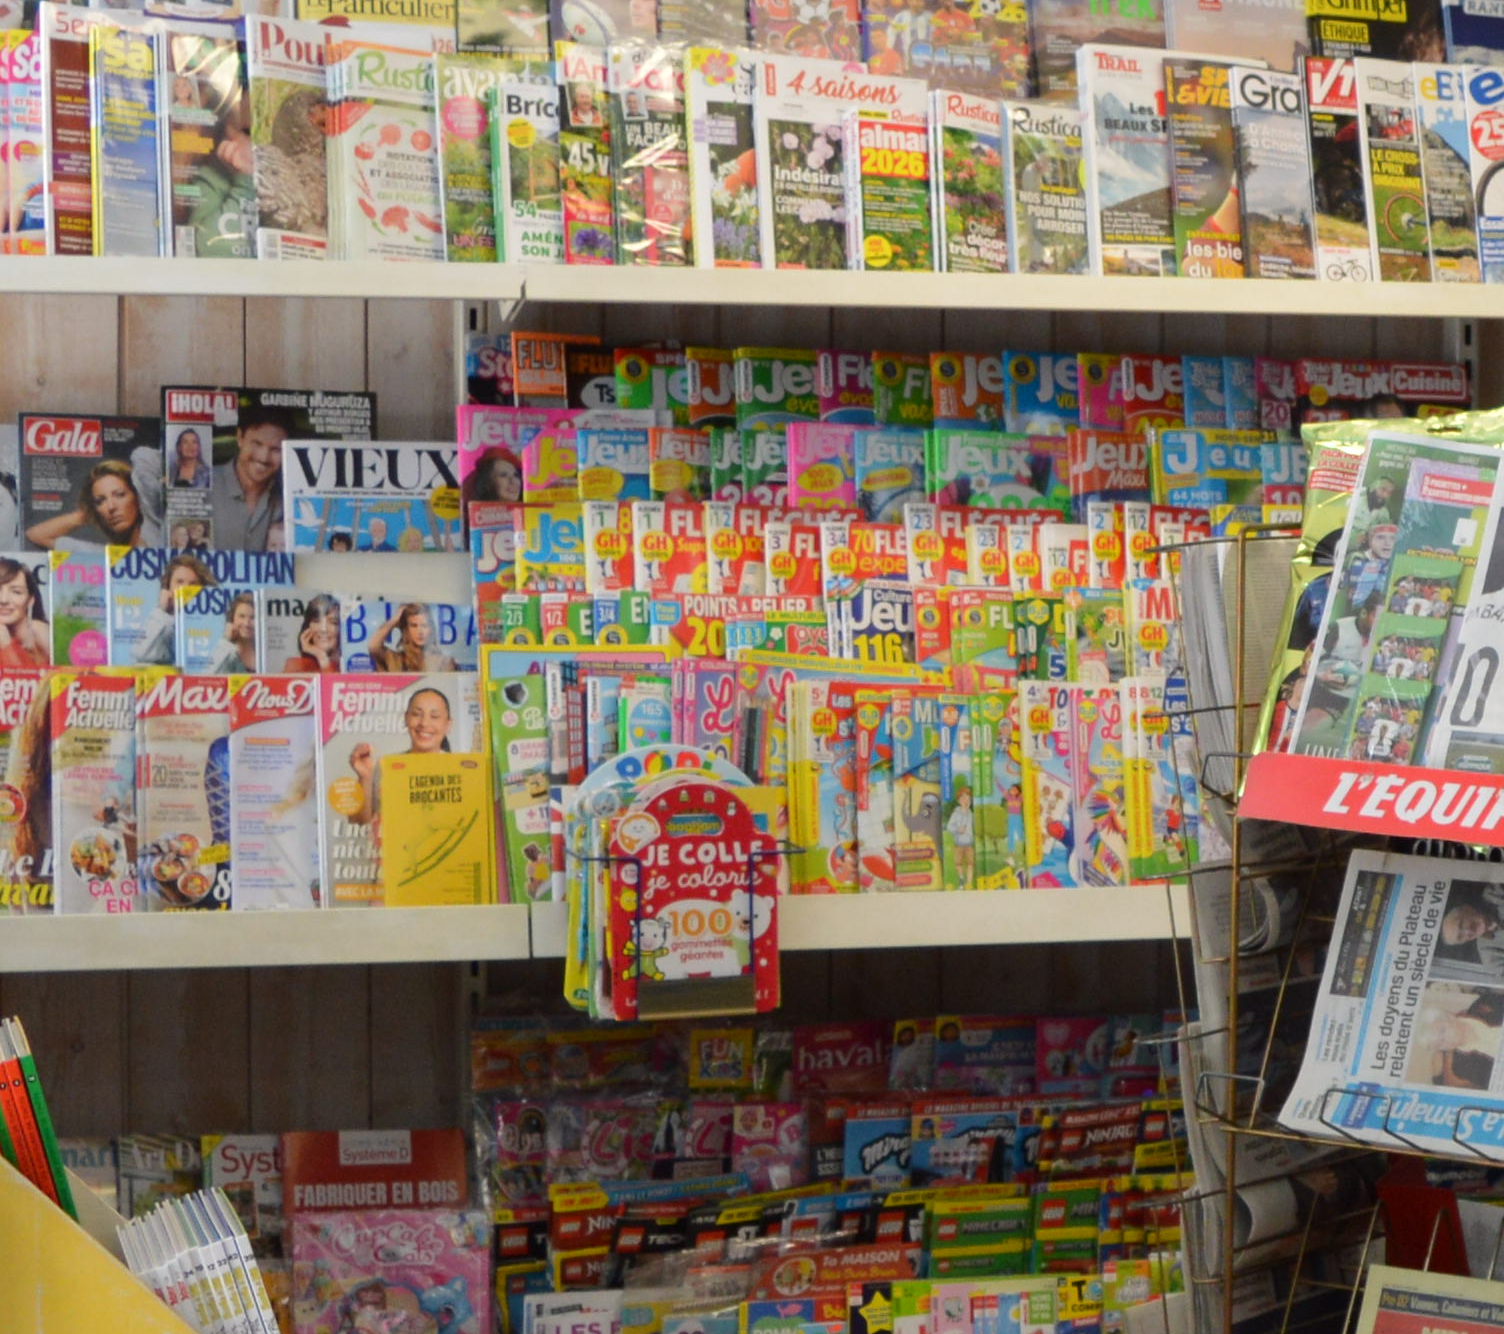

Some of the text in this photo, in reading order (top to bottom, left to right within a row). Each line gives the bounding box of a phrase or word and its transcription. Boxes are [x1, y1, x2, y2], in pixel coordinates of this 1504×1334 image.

[786, 72, 902, 105] 4 saisons
[568, 143, 596, 172] 45
[861, 148, 925, 177] 2026
[26, 419, 98, 453] Gala
[297, 449, 459, 490] VIEUX
[409, 775, 461, 788] L'AGENDA DES
[409, 788, 462, 804] BROCANTES
[642, 840, 763, 866] JE COLLE
[643, 864, 763, 900] je colorie
[668, 909, 732, 937] 100
[680, 949, 724, 962] géantes
[1371, 884, 1427, 1070] Les doyens du Plateau
[1390, 881, 1447, 1078] relatent un siècle de vie
[295, 1180, 460, 1208] FABRIQUER EN BOIS
